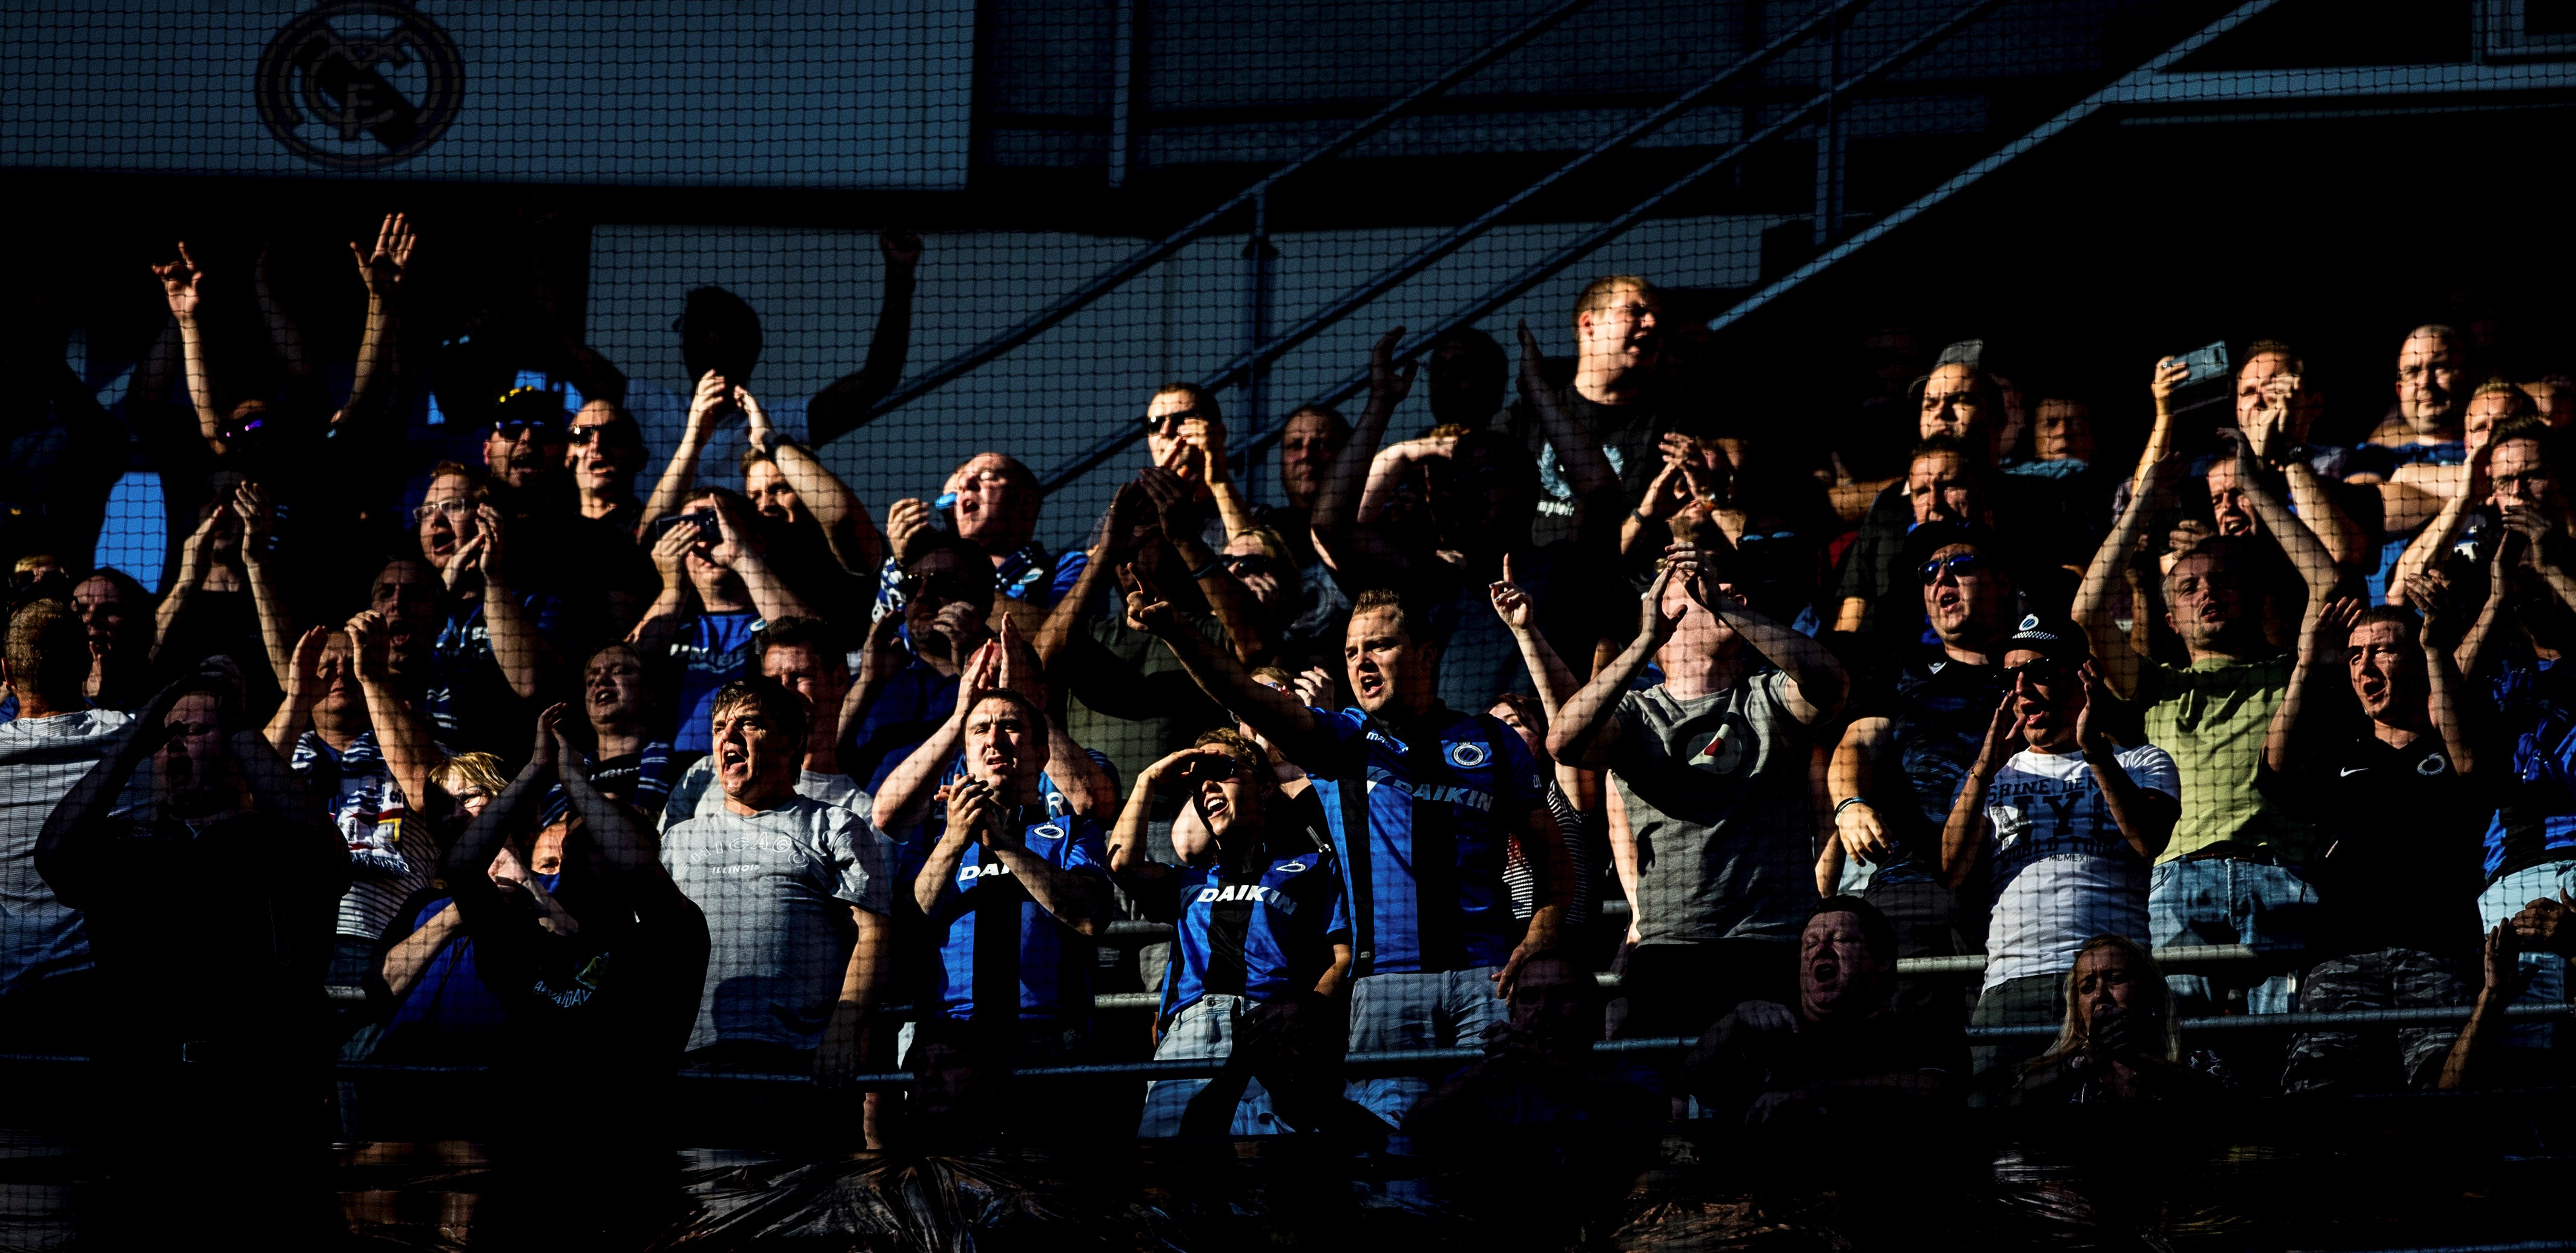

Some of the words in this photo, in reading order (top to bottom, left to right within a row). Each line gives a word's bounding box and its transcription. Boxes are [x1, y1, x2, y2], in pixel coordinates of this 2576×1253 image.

[670, 643, 751, 666] UNIBE
[1393, 778, 1494, 812] DAIKIN
[1989, 778, 2050, 804] SHINE
[2061, 776, 2099, 794] DEN
[712, 864, 761, 875] ILLINOIS
[958, 863, 1011, 882] DAI
[1196, 884, 1298, 916] DAIKIN
